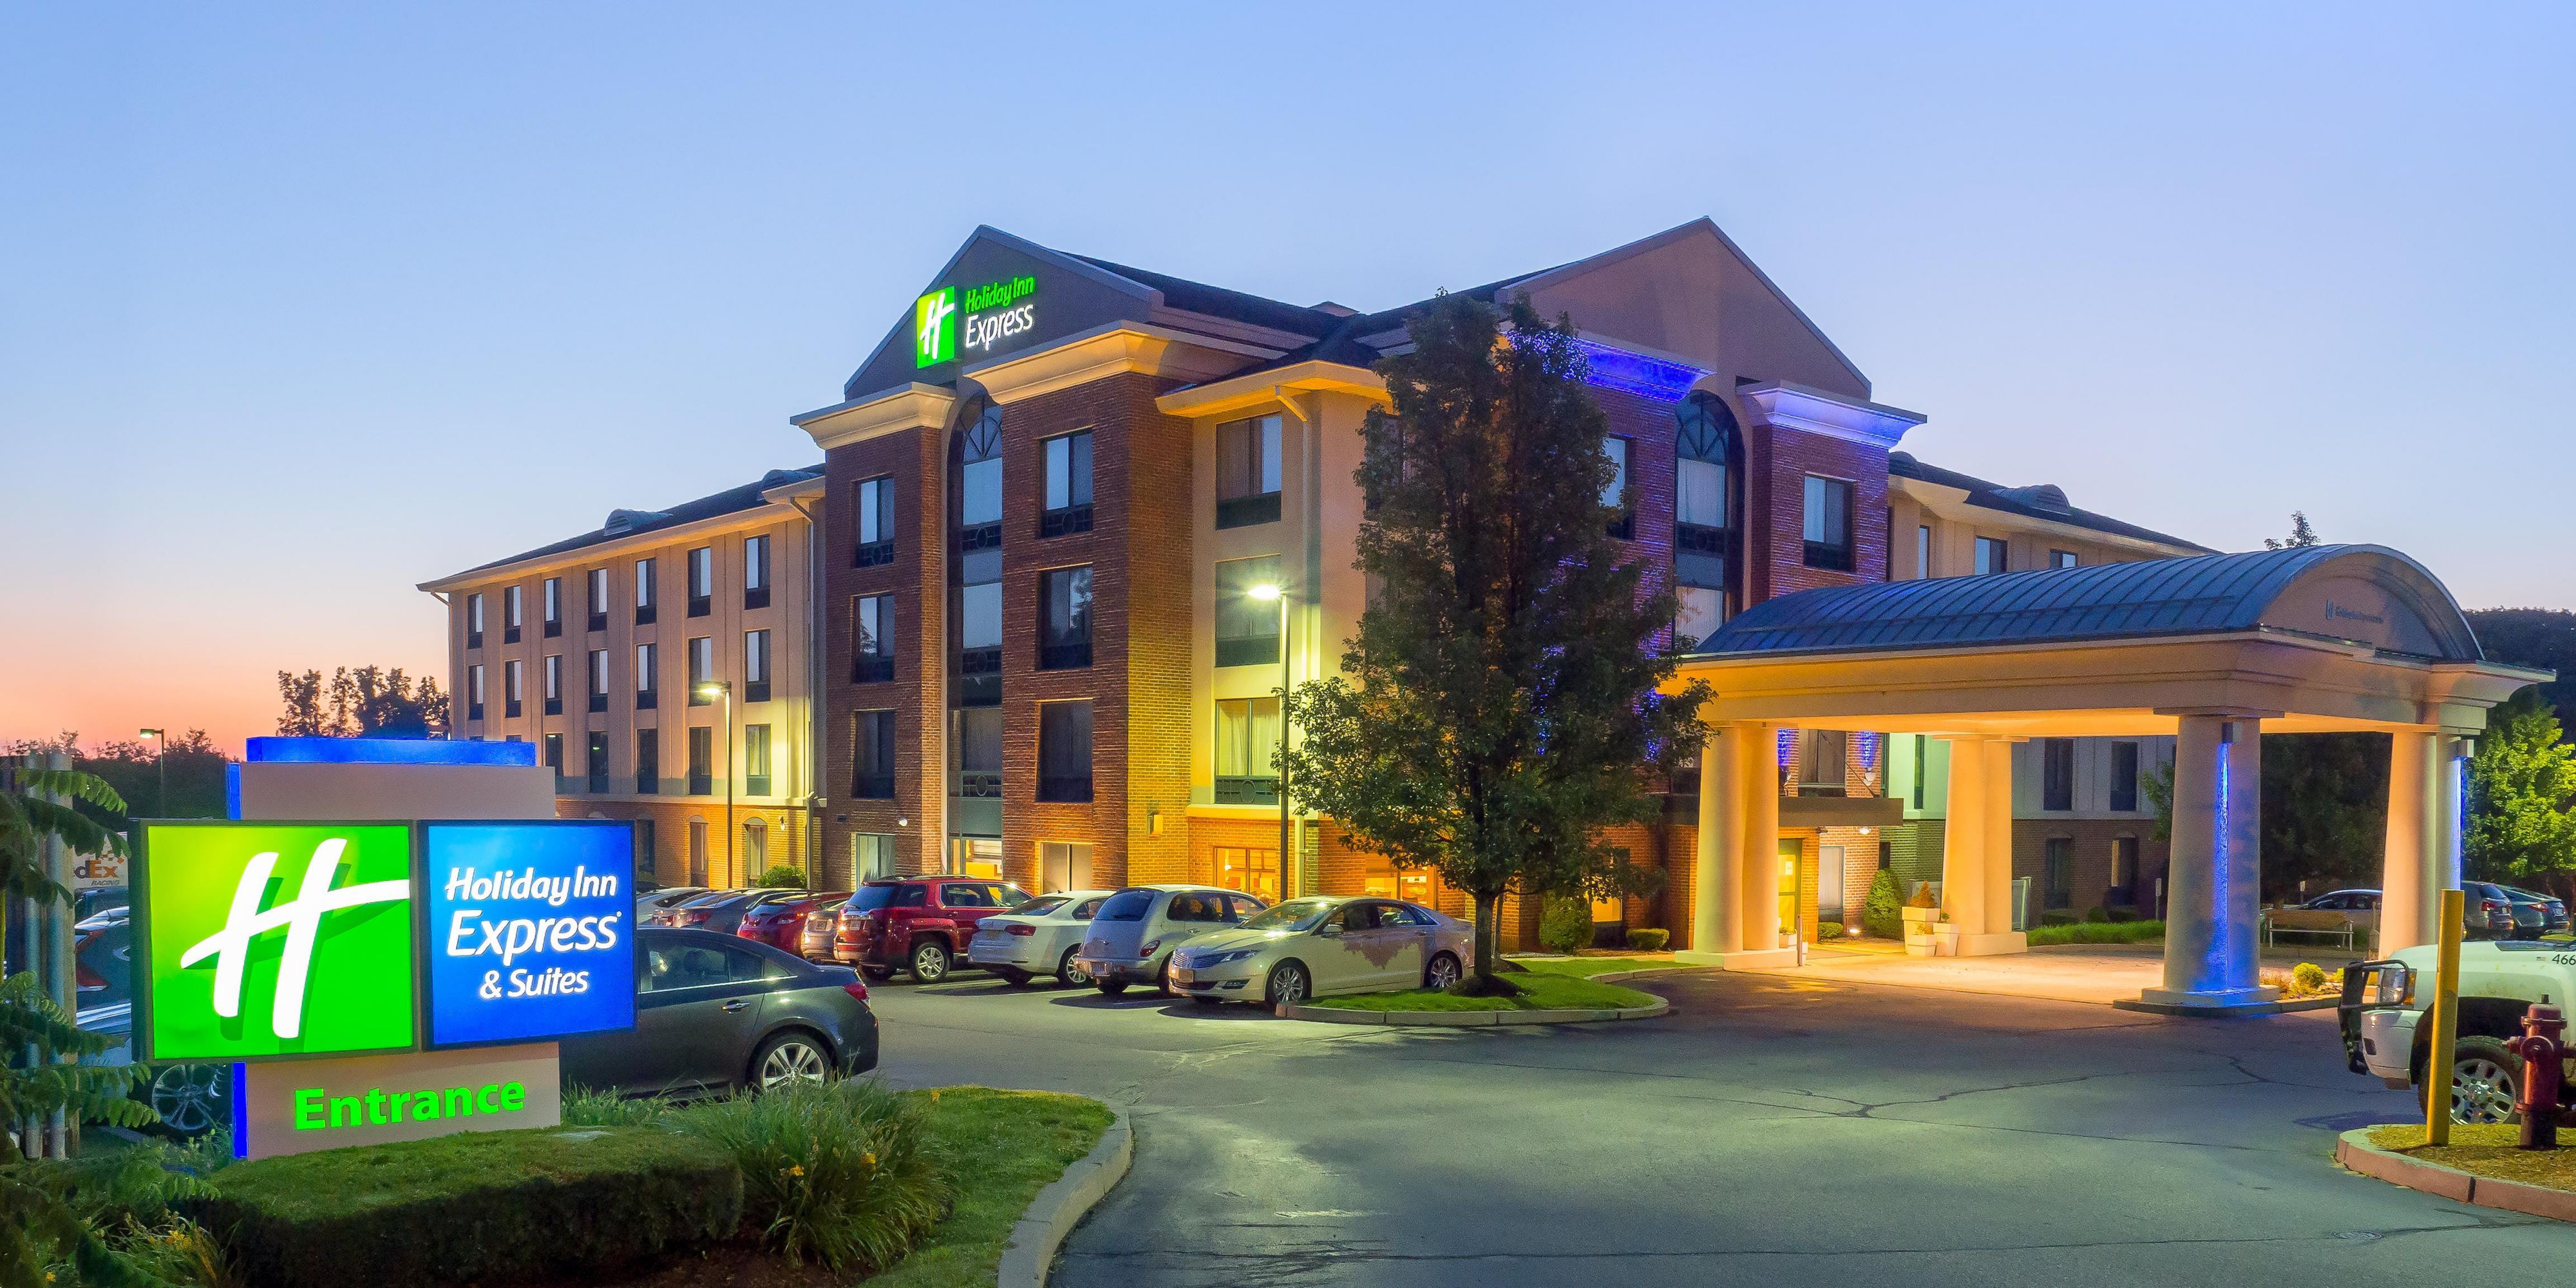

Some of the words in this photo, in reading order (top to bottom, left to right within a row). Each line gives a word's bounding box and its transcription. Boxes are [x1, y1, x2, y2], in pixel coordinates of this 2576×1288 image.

[965, 282, 1012, 314] Holiday
[1013, 276, 1035, 298] Inn
[920, 292, 954, 359] H
[965, 304, 1034, 351] Express
[73, 859, 118, 878] dEx
[444, 867, 571, 906] Holiday
[573, 865, 618, 898] Inn
[180, 838, 410, 1038] H
[447, 909, 618, 967] Express
[2552, 954, 2576, 965] 466
[478, 970, 503, 999] &
[507, 967, 590, 998] Suites
[294, 1081, 525, 1130] Entrance
